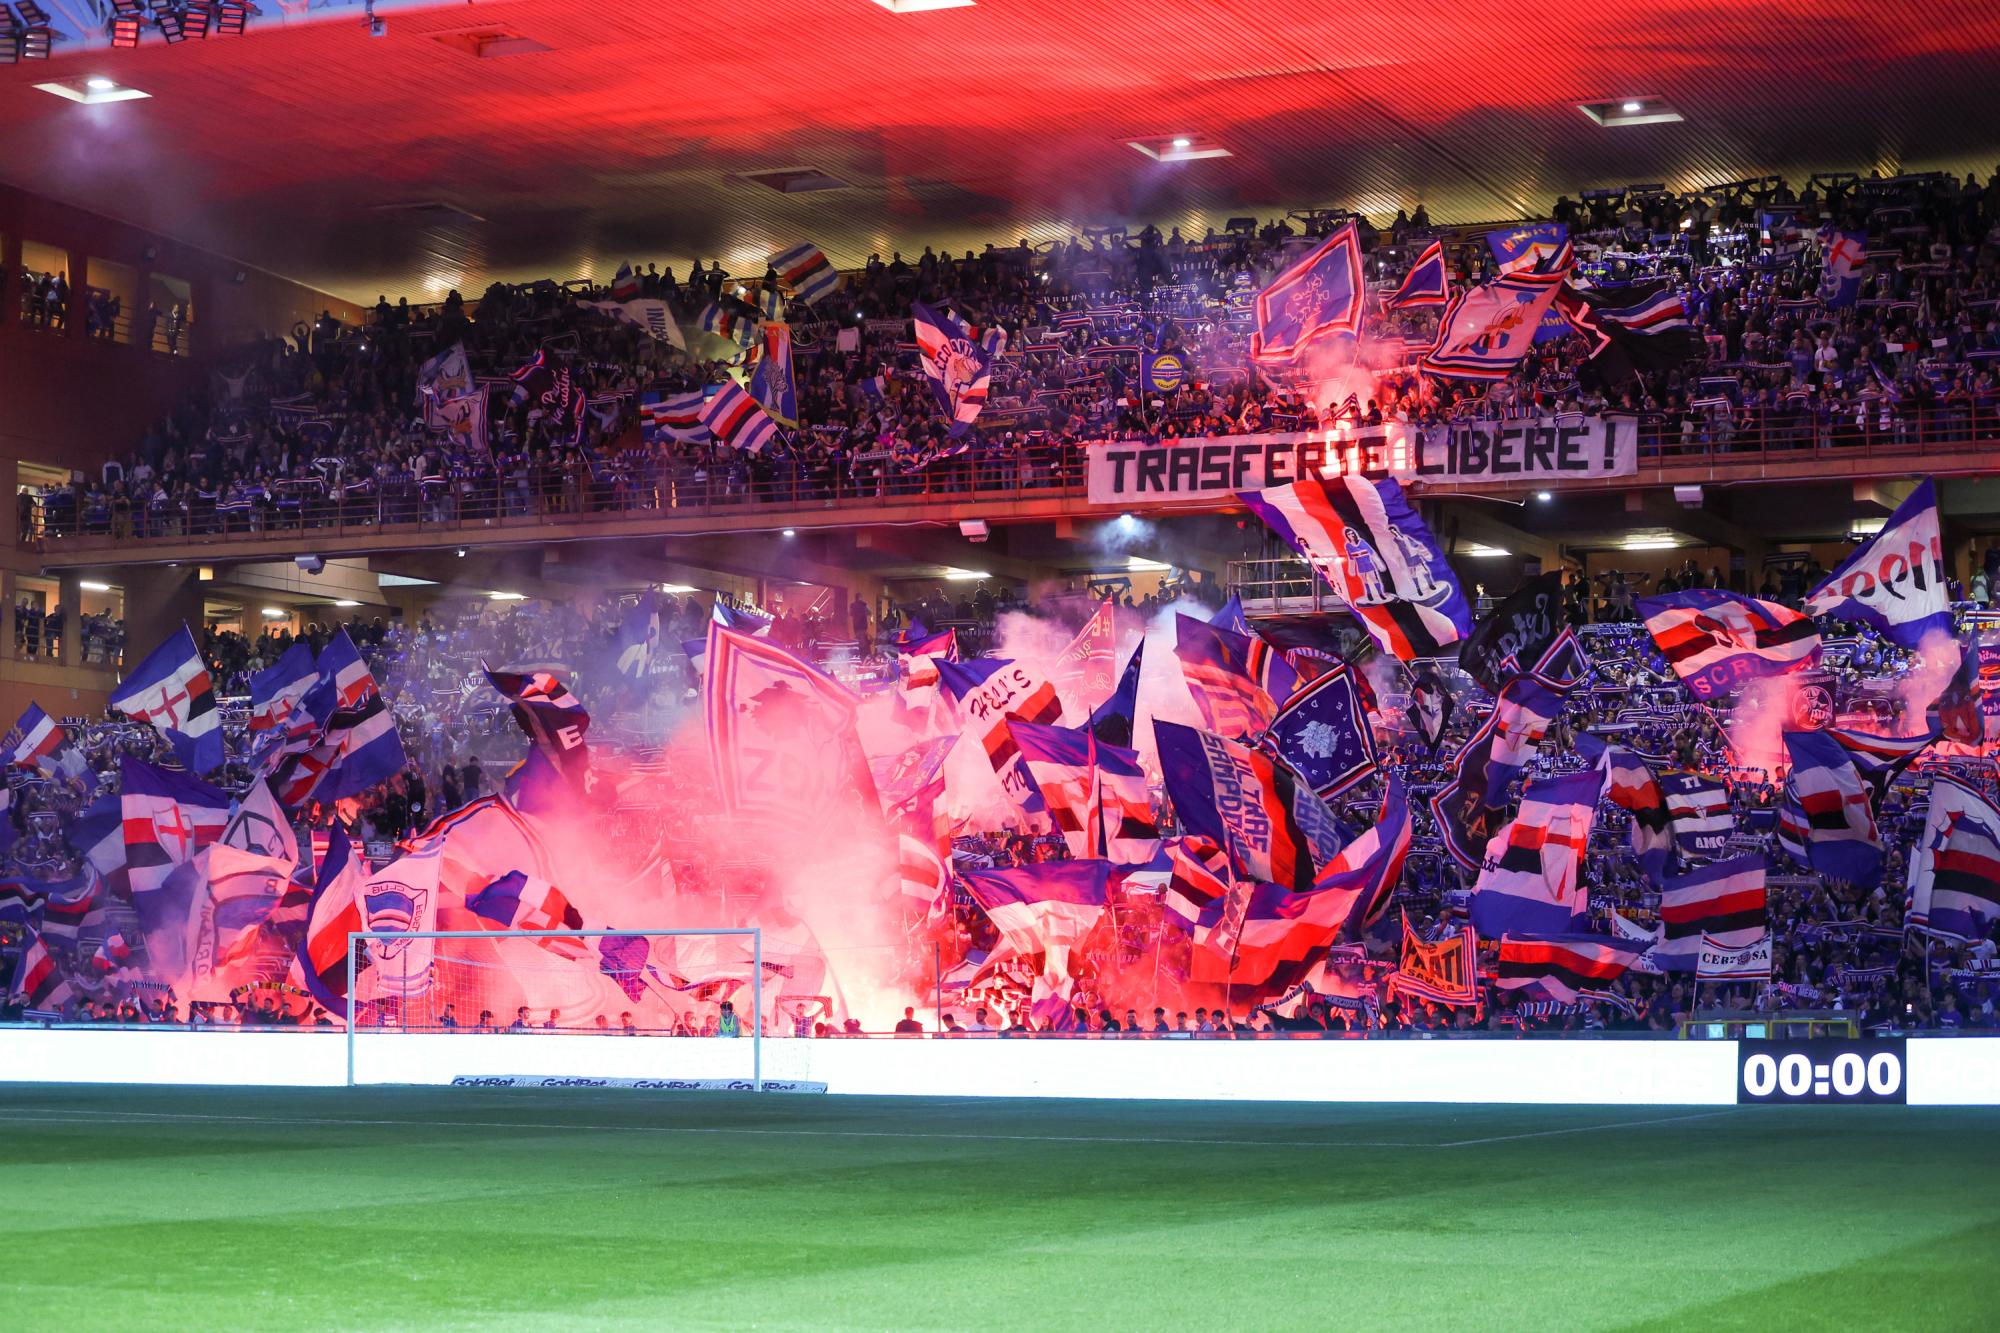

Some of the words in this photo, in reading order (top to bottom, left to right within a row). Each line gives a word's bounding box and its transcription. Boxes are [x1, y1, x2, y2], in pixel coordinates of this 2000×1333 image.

[1106, 437, 1390, 493] TRASFERTE
[1680, 775, 1702, 789] TI
[1695, 836, 1725, 849] AMO
[1702, 949, 1768, 965] CERTSA
[1743, 1052, 1902, 1097] 00:00
